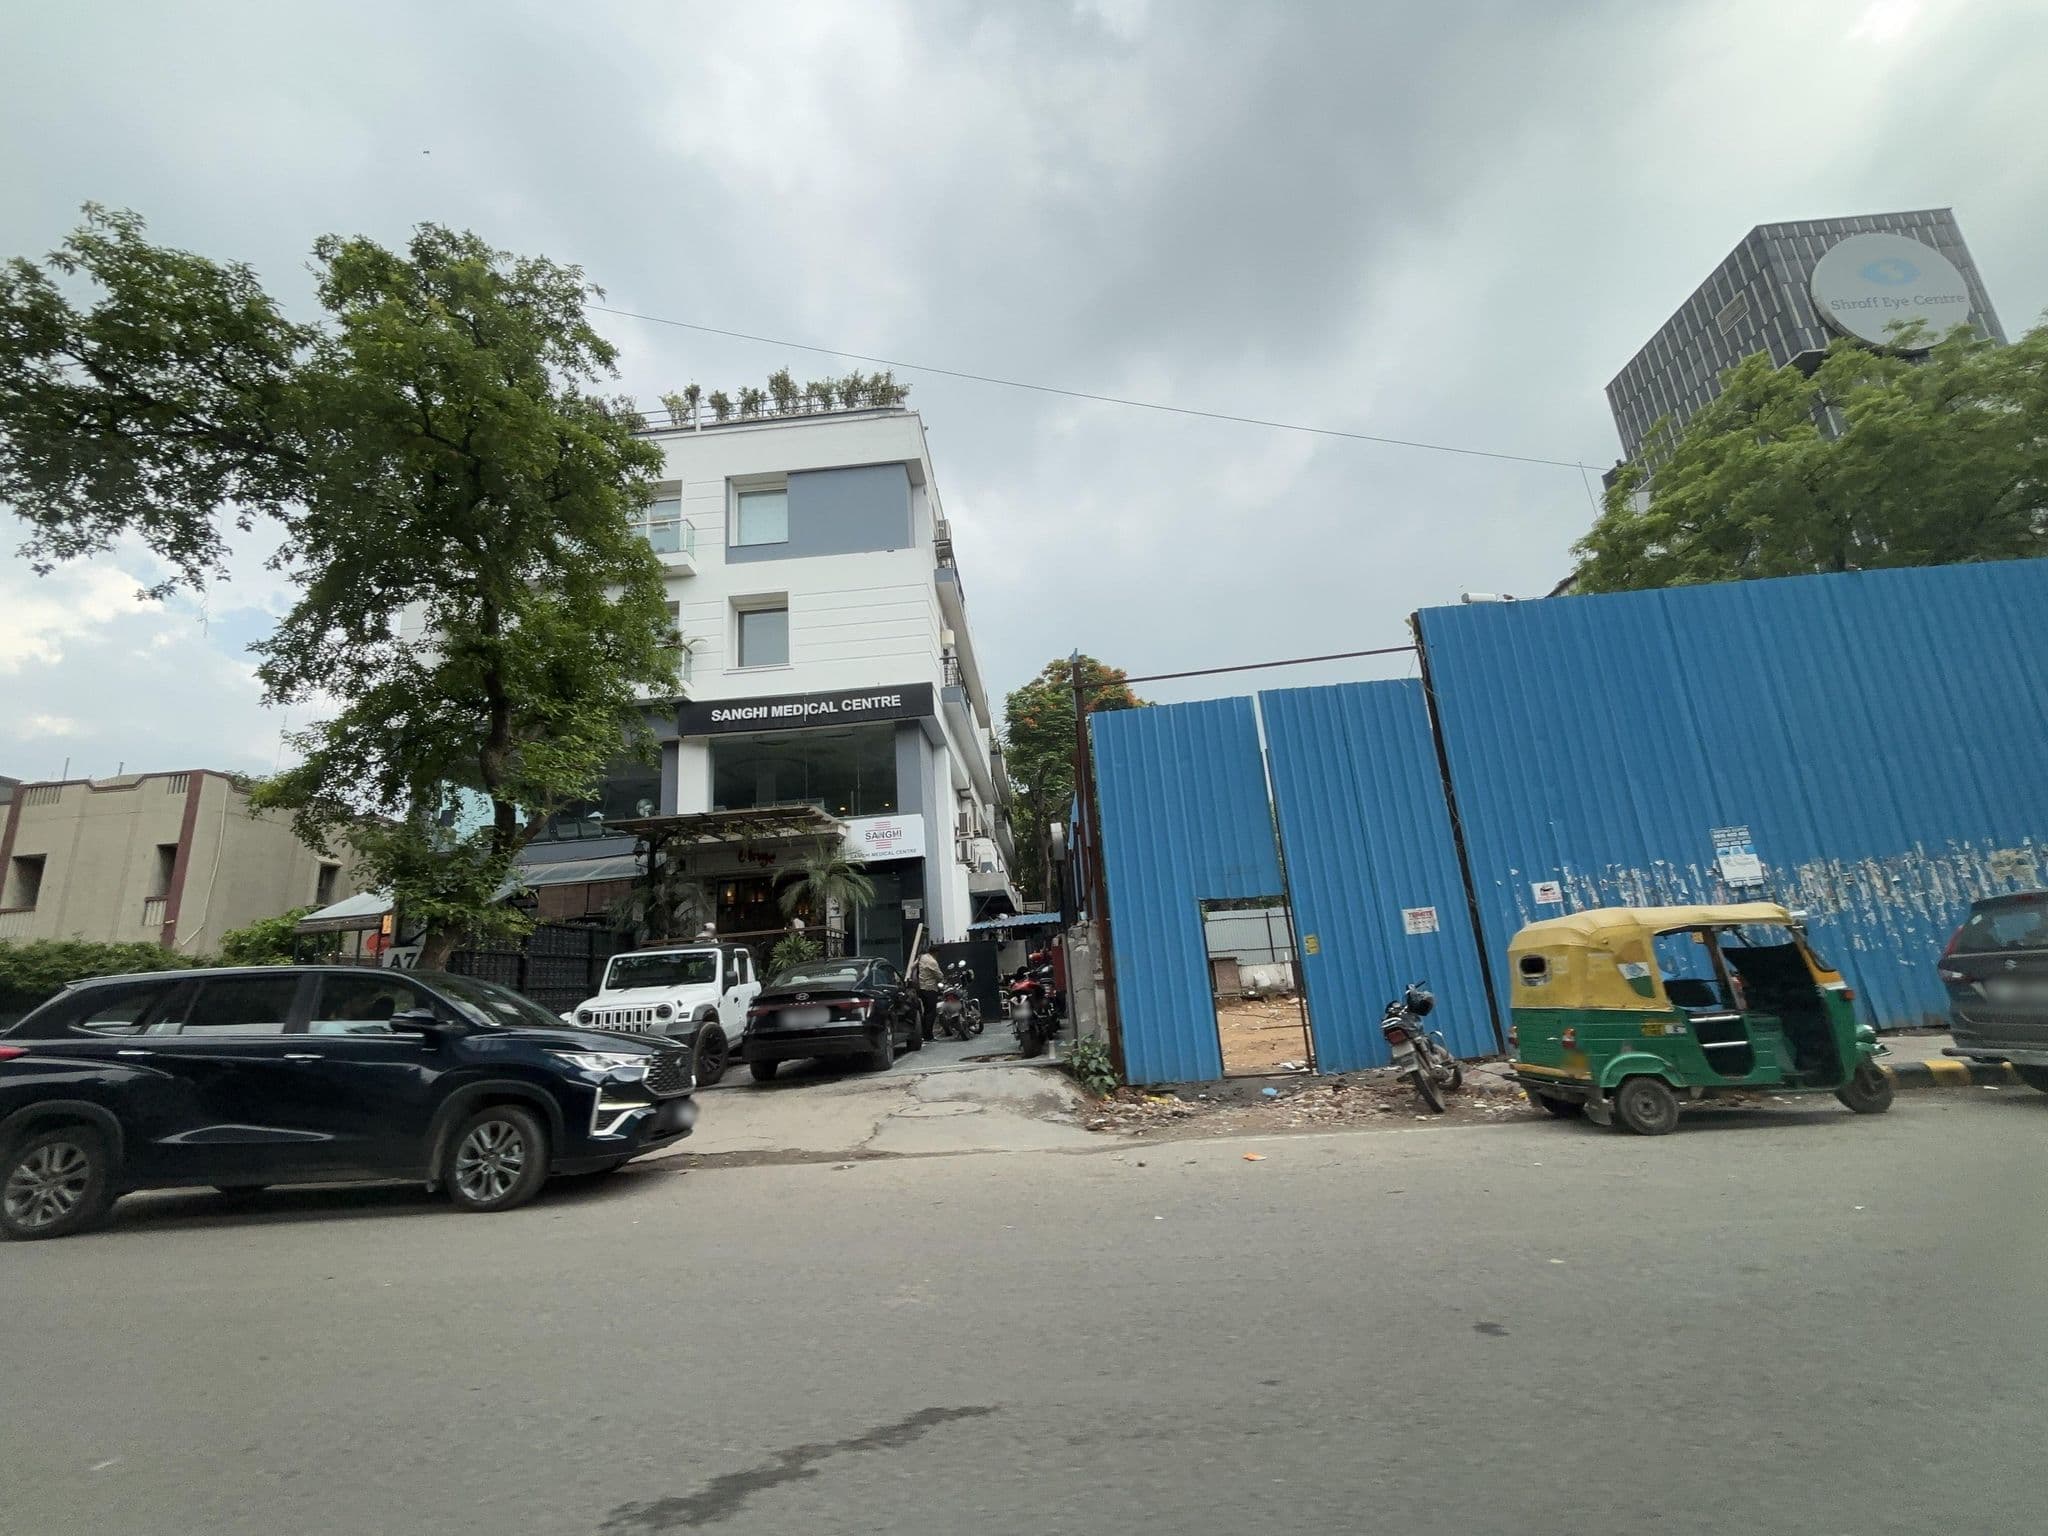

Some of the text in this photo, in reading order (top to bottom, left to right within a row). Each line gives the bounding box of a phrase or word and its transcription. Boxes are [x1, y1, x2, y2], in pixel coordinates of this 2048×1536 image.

[1831, 294, 1965, 310] Shroff Eye Centre
[711, 695, 901, 721] SANGHI MEDICAL CENTRE
[865, 829, 902, 841] SANGHI
[871, 850, 895, 858] MEDICAL
[895, 848, 917, 856] CENTRE
[390, 952, 417, 969] A7
